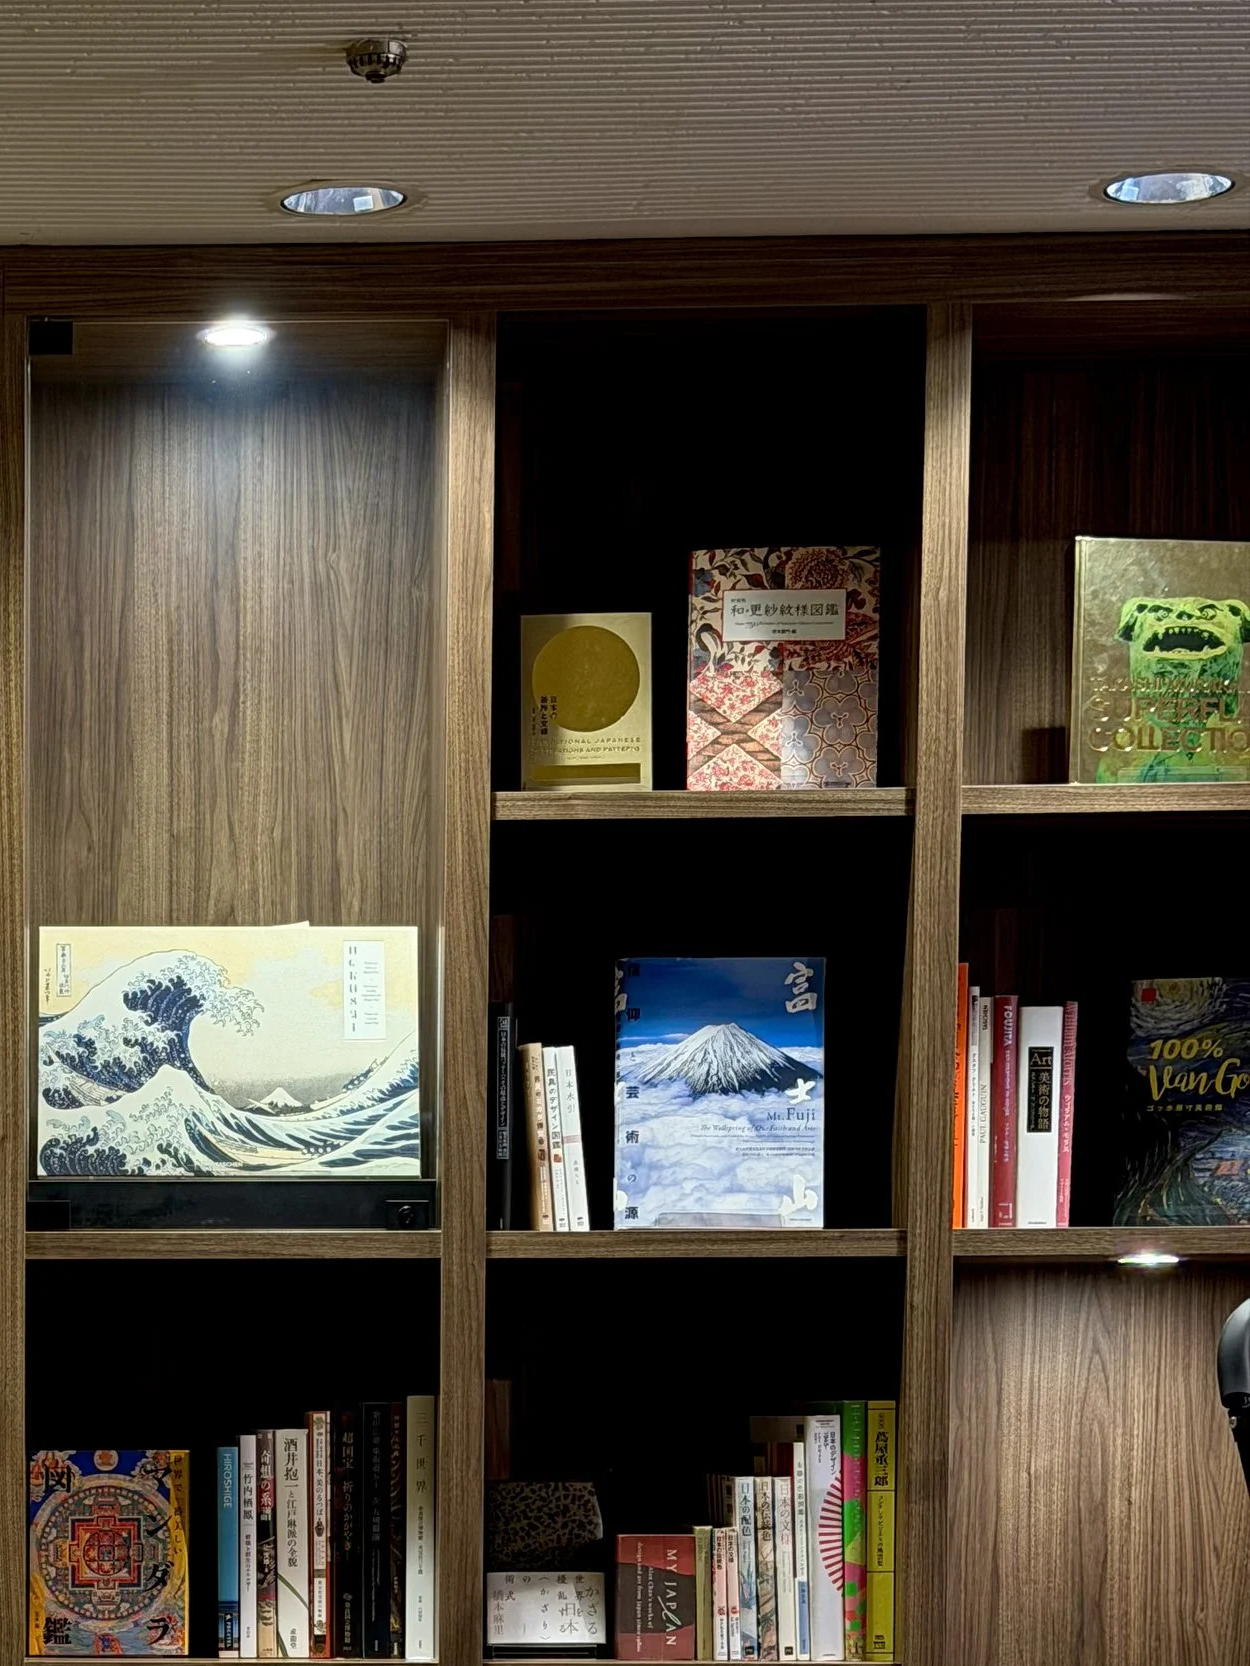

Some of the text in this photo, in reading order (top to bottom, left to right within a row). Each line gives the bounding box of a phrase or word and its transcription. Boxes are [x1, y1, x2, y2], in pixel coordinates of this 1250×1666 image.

[1030, 1053, 1052, 1066] Art
[1150, 1039, 1223, 1059] 100%
[778, 962, 819, 1216] 富士山
[223, 1454, 232, 1509] HIROSHIGE
[741, 1483, 751, 1536] 日本の配色
[143, 1466, 174, 1646] マンダラ
[666, 1549, 678, 1572] MY
